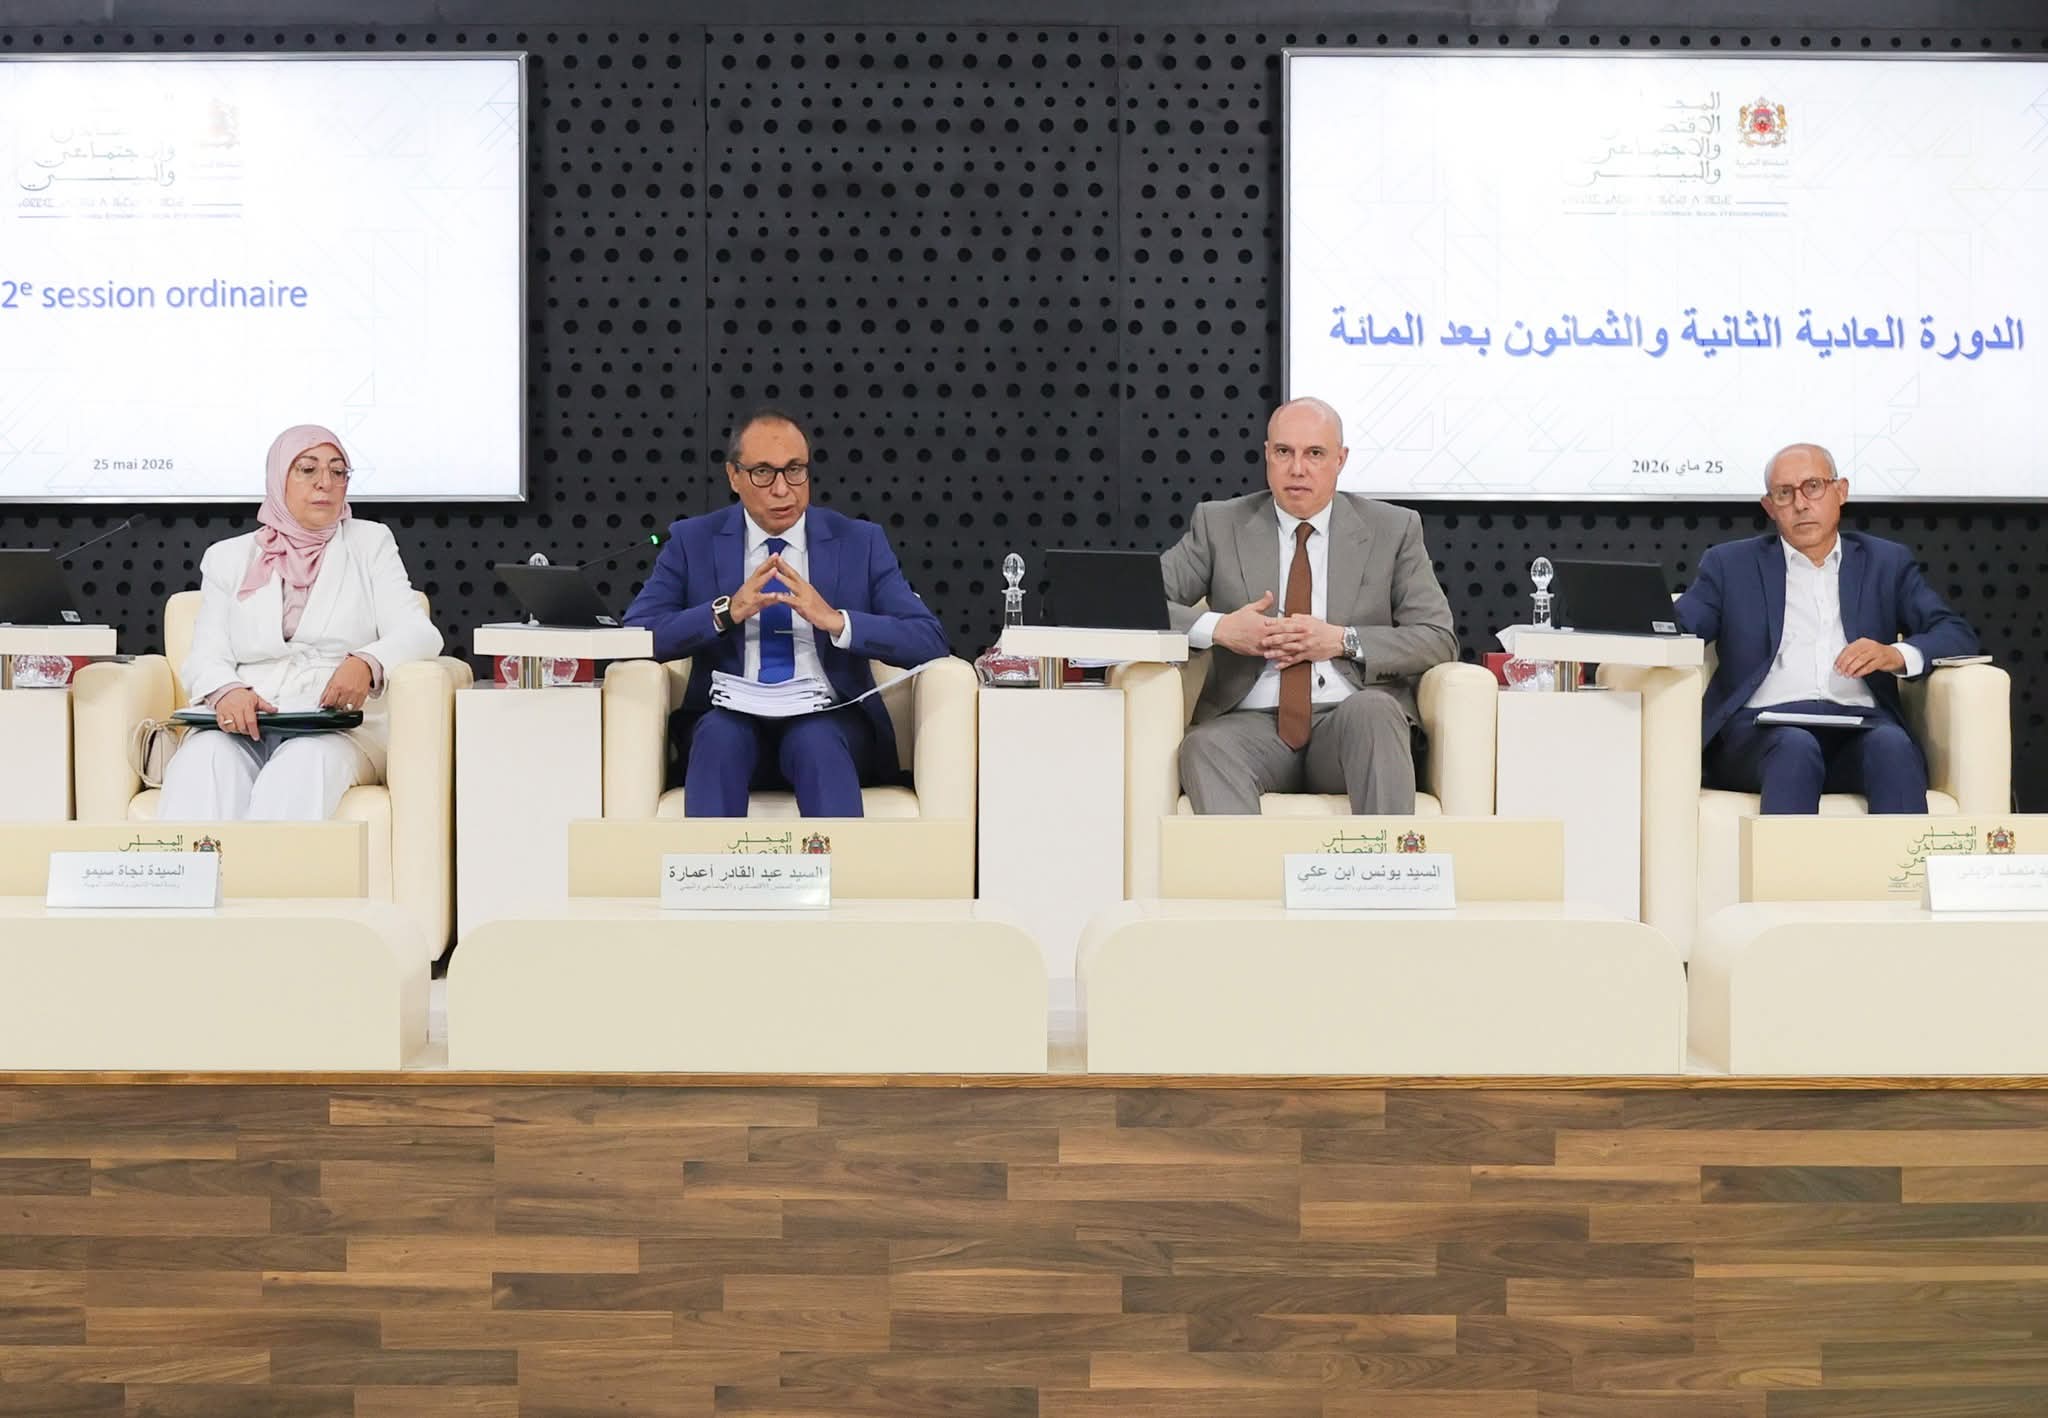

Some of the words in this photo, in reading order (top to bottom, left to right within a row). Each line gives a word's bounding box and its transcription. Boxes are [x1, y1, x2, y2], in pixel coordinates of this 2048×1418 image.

[42, 279, 155, 309] session
[166, 277, 308, 309] ordinaire
[1329, 305, 1425, 347] المائة
[1503, 309, 1669, 359] والثمانون
[1680, 306, 1782, 359] الثانية
[1795, 307, 1905, 359] العادية
[1439, 320, 1492, 357] بعد
[1919, 314, 2025, 361] الدورة
[93, 458, 109, 471] 25
[113, 457, 138, 470] mai
[142, 458, 174, 471] 2026
[1632, 459, 1670, 474] 2026
[1676, 459, 1701, 476] ماي
[1705, 460, 1724, 474] 25
[148, 863, 185, 879] السيدة
[719, 864, 755, 882] القادر
[760, 866, 783, 881] عبد
[789, 865, 823, 881] السيد
[1297, 865, 1328, 882] عكي
[1334, 864, 1356, 881] ابن
[1361, 864, 1401, 881] يونس
[1406, 864, 1441, 881] السيد
